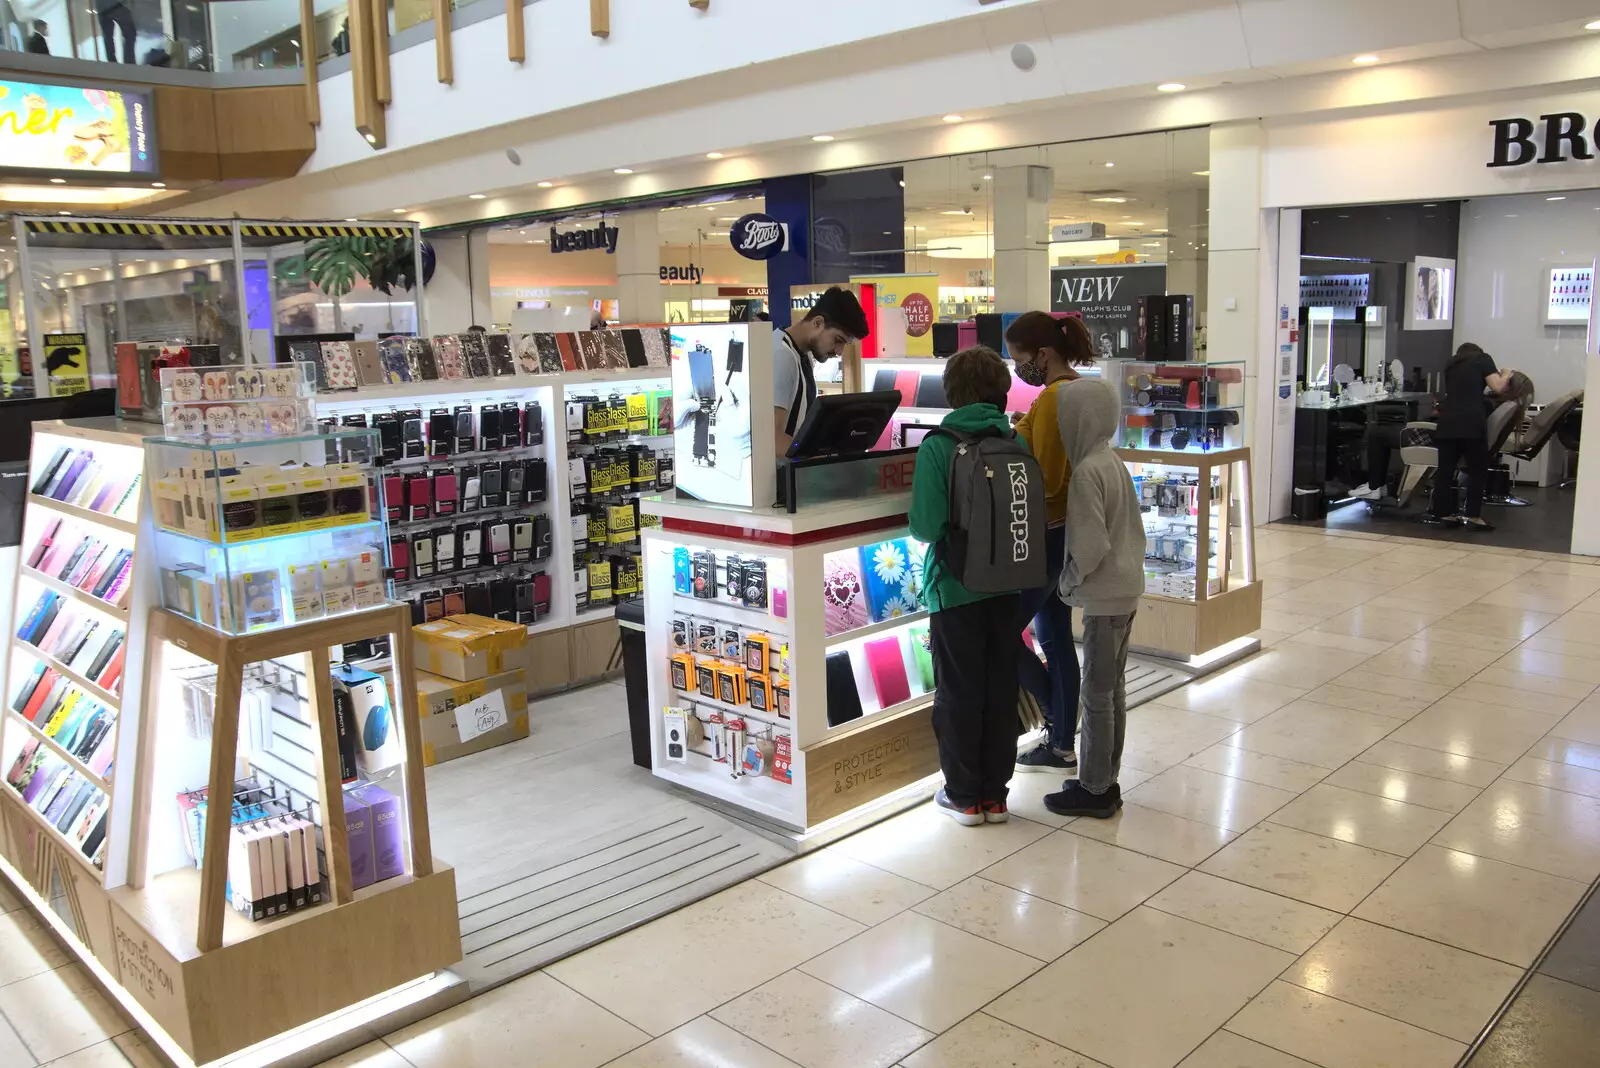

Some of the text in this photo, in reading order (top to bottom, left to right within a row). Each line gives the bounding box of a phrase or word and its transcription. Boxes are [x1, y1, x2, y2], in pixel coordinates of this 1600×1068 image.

[1486, 112, 1600, 167] BR
[551, 221, 619, 253] beauty
[740, 220, 780, 250] Boots
[1061, 228, 1083, 236] haircare
[1056, 276, 1124, 303] NEW
[905, 305, 929, 314] HALF
[905, 314, 930, 322] RICE
[587, 410, 607, 423] Glass
[630, 405, 647, 416] Glass
[591, 463, 630, 482] Glass Glass
[639, 459, 656, 471] Glass
[1007, 463, 1028, 562] Kappa
[616, 516, 634, 528] Glass
[592, 573, 610, 586] Glass
[618, 572, 636, 583] Glass
[834, 734, 911, 776] PROTECTION
[834, 763, 882, 794] & STYLE
[116, 926, 174, 996] PROTECTION
